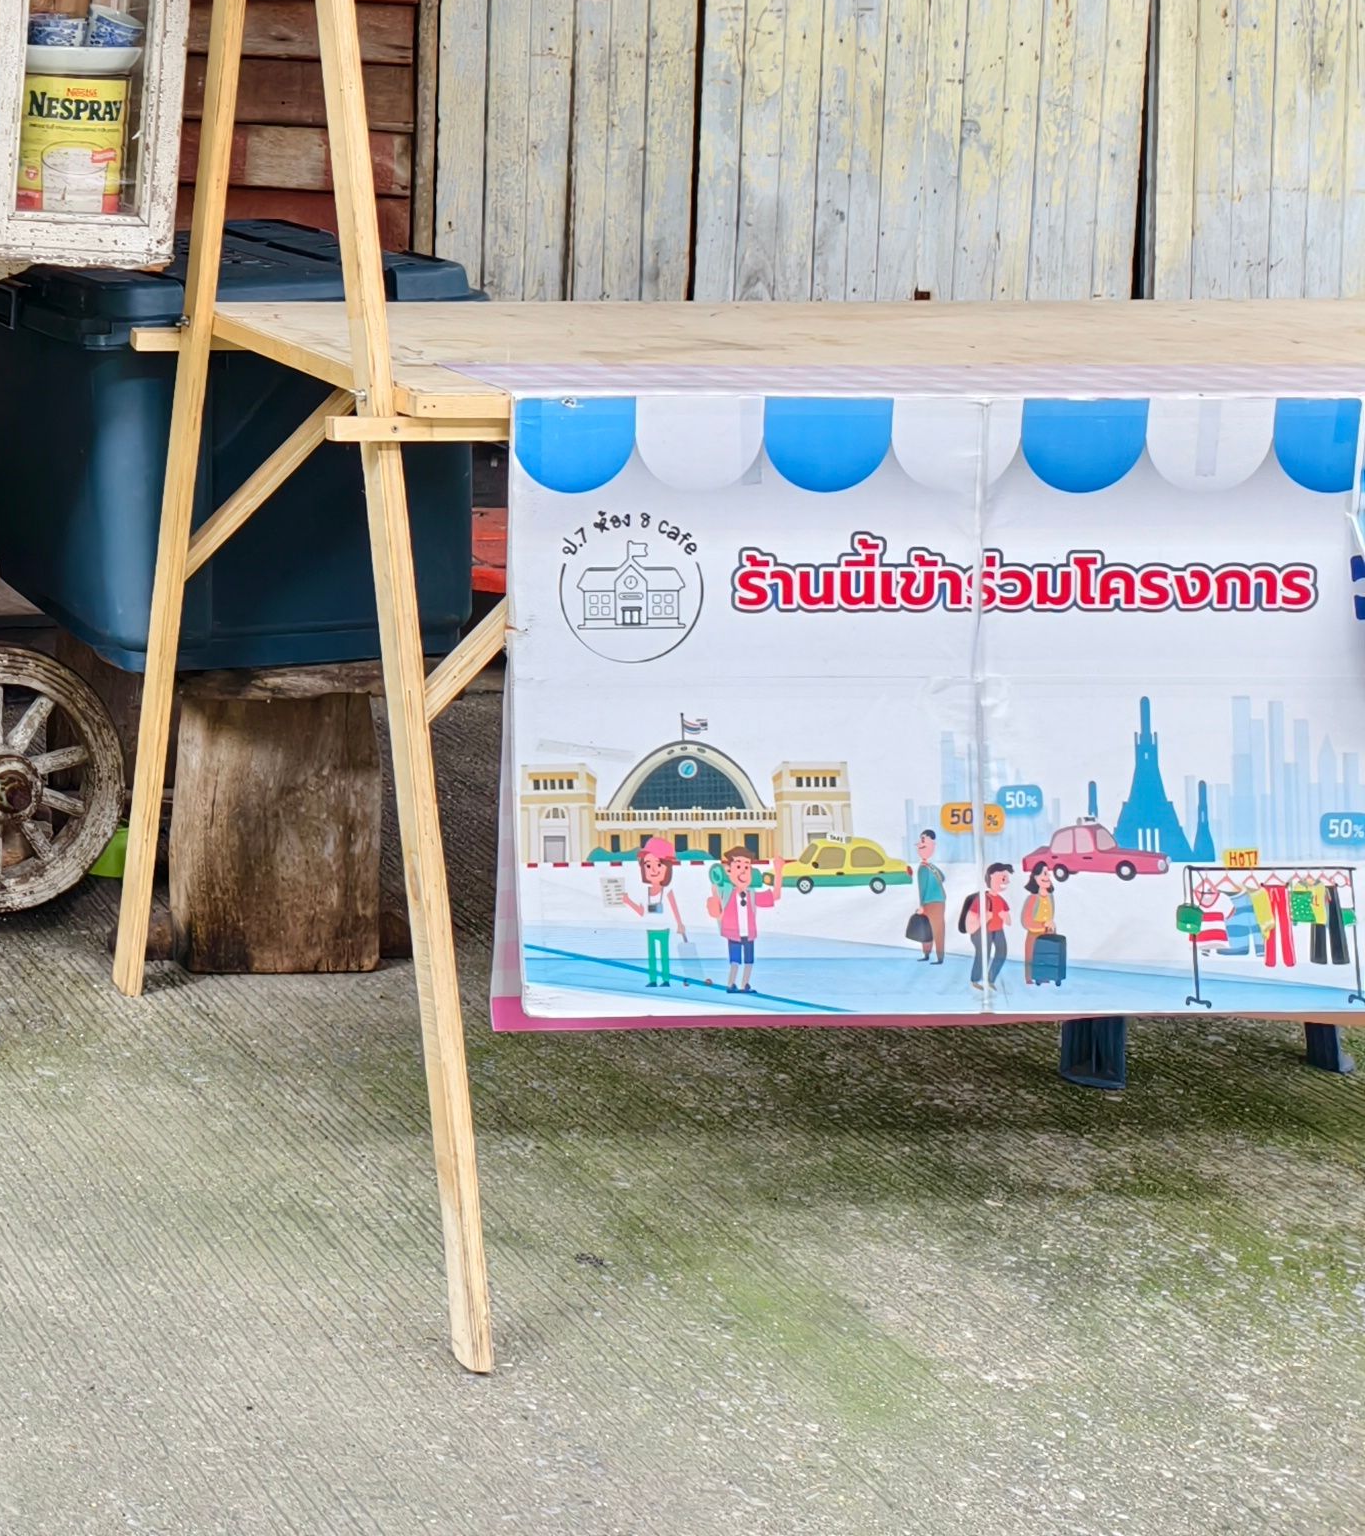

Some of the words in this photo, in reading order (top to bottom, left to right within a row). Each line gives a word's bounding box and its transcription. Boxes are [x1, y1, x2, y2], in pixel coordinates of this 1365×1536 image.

[28, 90, 122, 121] NESPRAY
[640, 512, 651, 529] 8
[658, 520, 698, 556] cafe
[735, 534, 1313, 609] ร้านนี้เข้าร่วมโครงการ
[1005, 790, 1038, 809] 50%
[1328, 817, 1365, 839] 50%
[1229, 850, 1258, 866] HOT!
